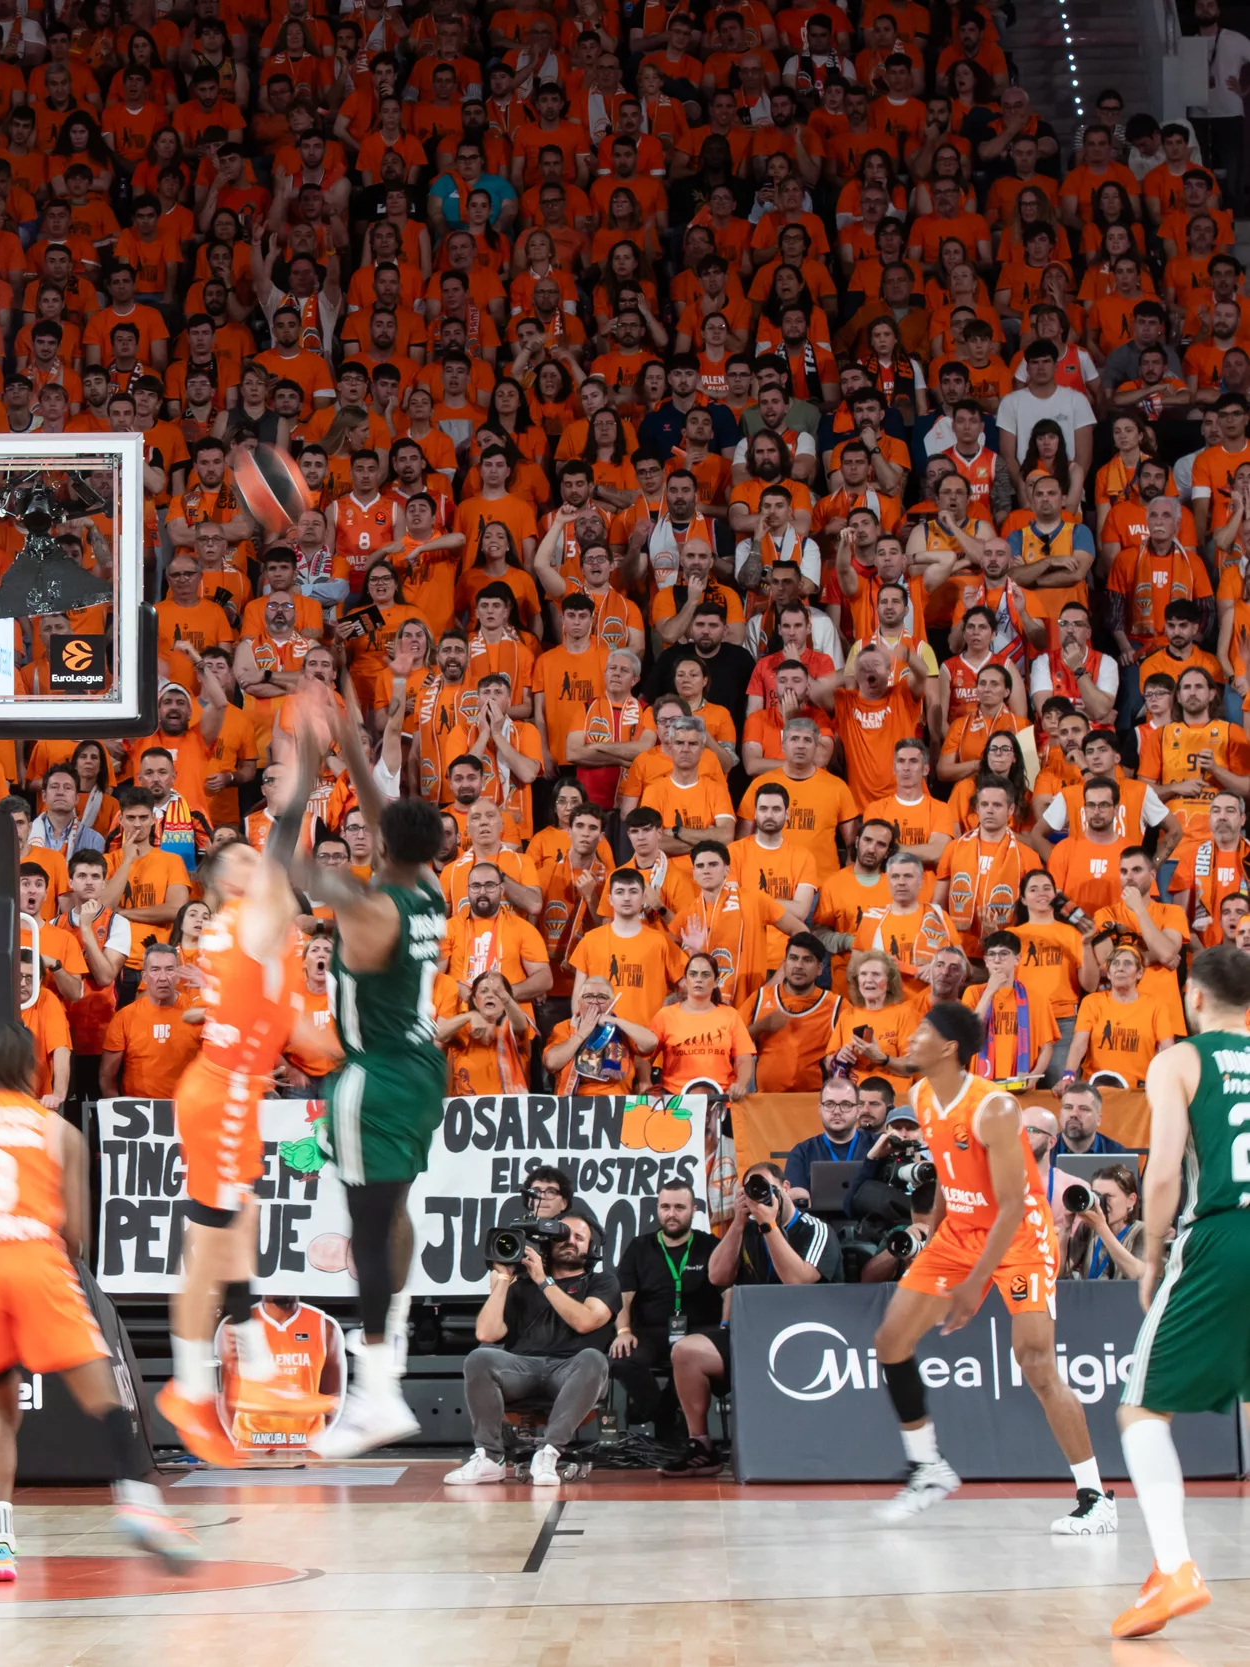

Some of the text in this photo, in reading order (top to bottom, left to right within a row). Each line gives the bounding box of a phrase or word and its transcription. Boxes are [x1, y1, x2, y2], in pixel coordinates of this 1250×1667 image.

[358, 532, 370, 549] 8
[51, 674, 104, 684] EuroLeague
[1187, 754, 1197, 772] 9
[1090, 859, 1108, 873] VBC
[1217, 868, 1234, 882] VBC
[153, 1024, 170, 1038] VBC
[942, 1151, 956, 1180] 1
[557, 1154, 699, 1196] NOSTRES
[1030, 1273, 1038, 1302] 1
[802, 1347, 982, 1390] Miea
[251, 1432, 307, 1445] YANKUBA SIMA
